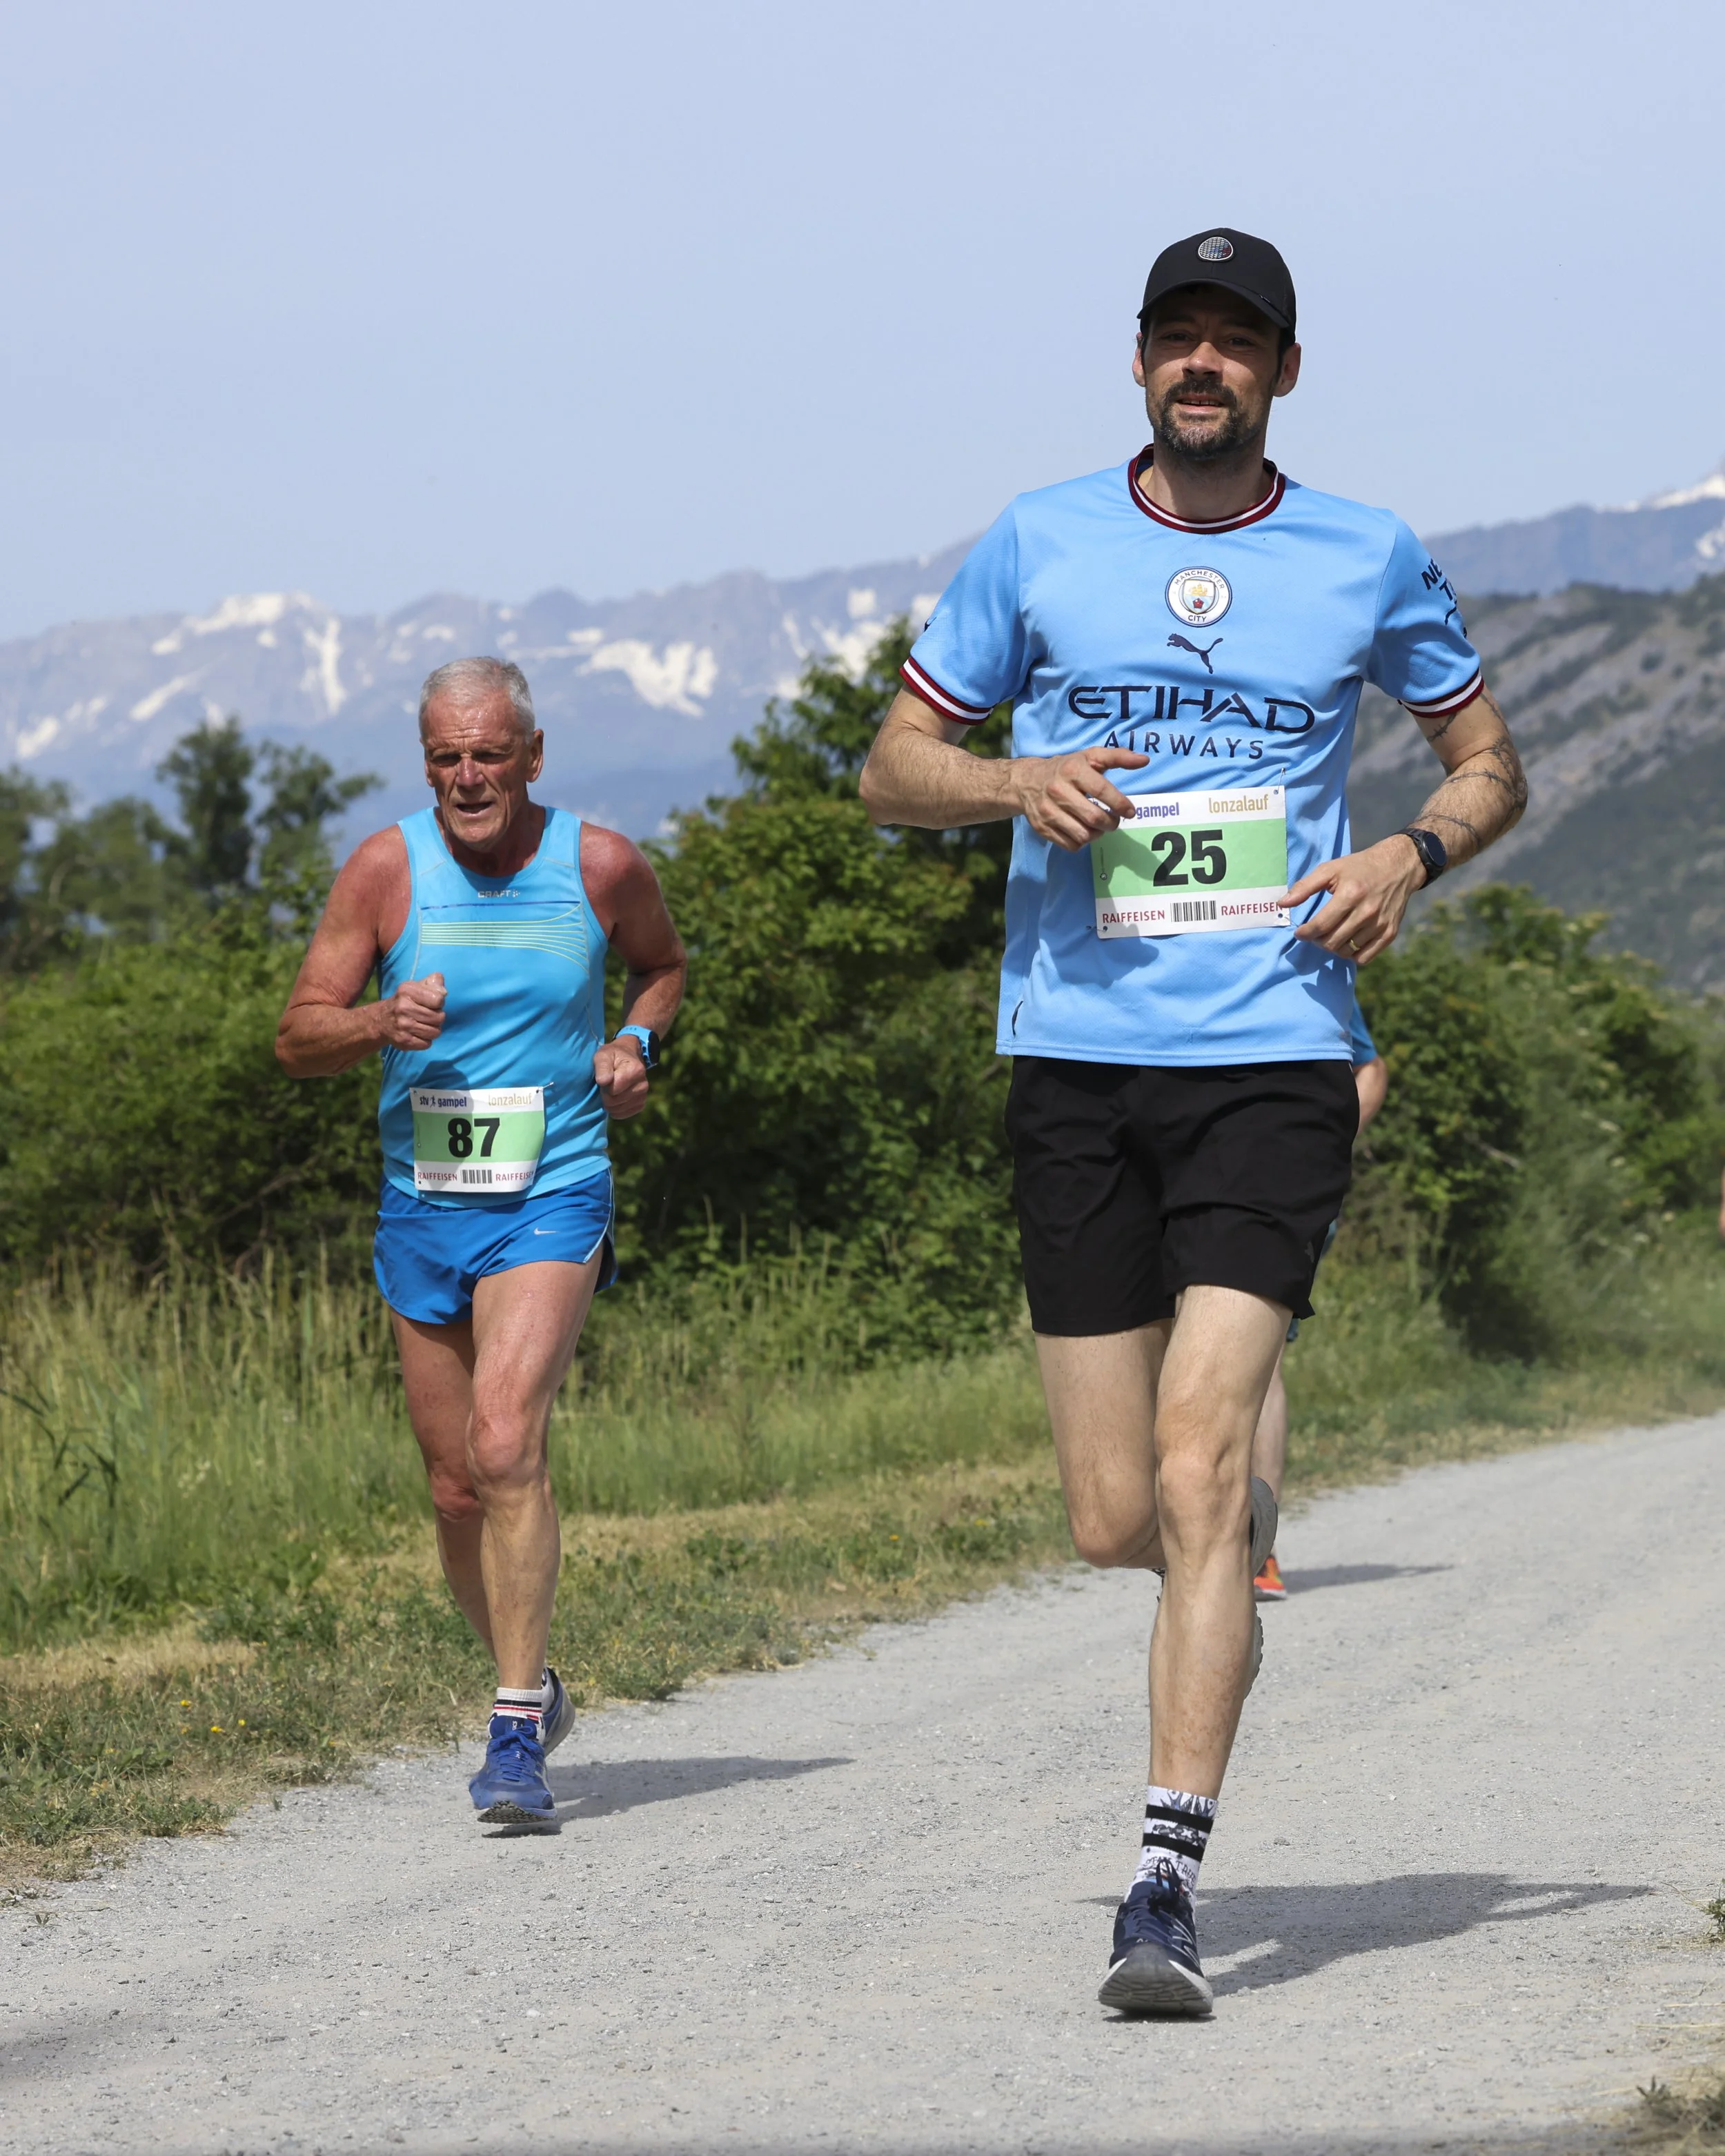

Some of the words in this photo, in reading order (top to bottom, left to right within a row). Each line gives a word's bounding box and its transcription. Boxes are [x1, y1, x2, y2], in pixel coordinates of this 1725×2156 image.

[1174, 570, 1225, 589] MANCHESTER
[1068, 686, 1315, 733] ETIHAD
[1104, 730, 1263, 760] AIRWAYS
[1136, 802, 1180, 820] gampel
[1208, 793, 1269, 813] lonzalauf
[1151, 829, 1227, 887] 25
[477, 889, 511, 898] CRAFT
[1103, 909, 1165, 924] RAIFFEISEN
[420, 1096, 429, 1105] stv
[437, 1096, 467, 1108] gampel
[488, 1093, 532, 1106] lonzalauf
[447, 1117, 500, 1158] 87
[417, 1171, 457, 1181] RAIFFEISEN
